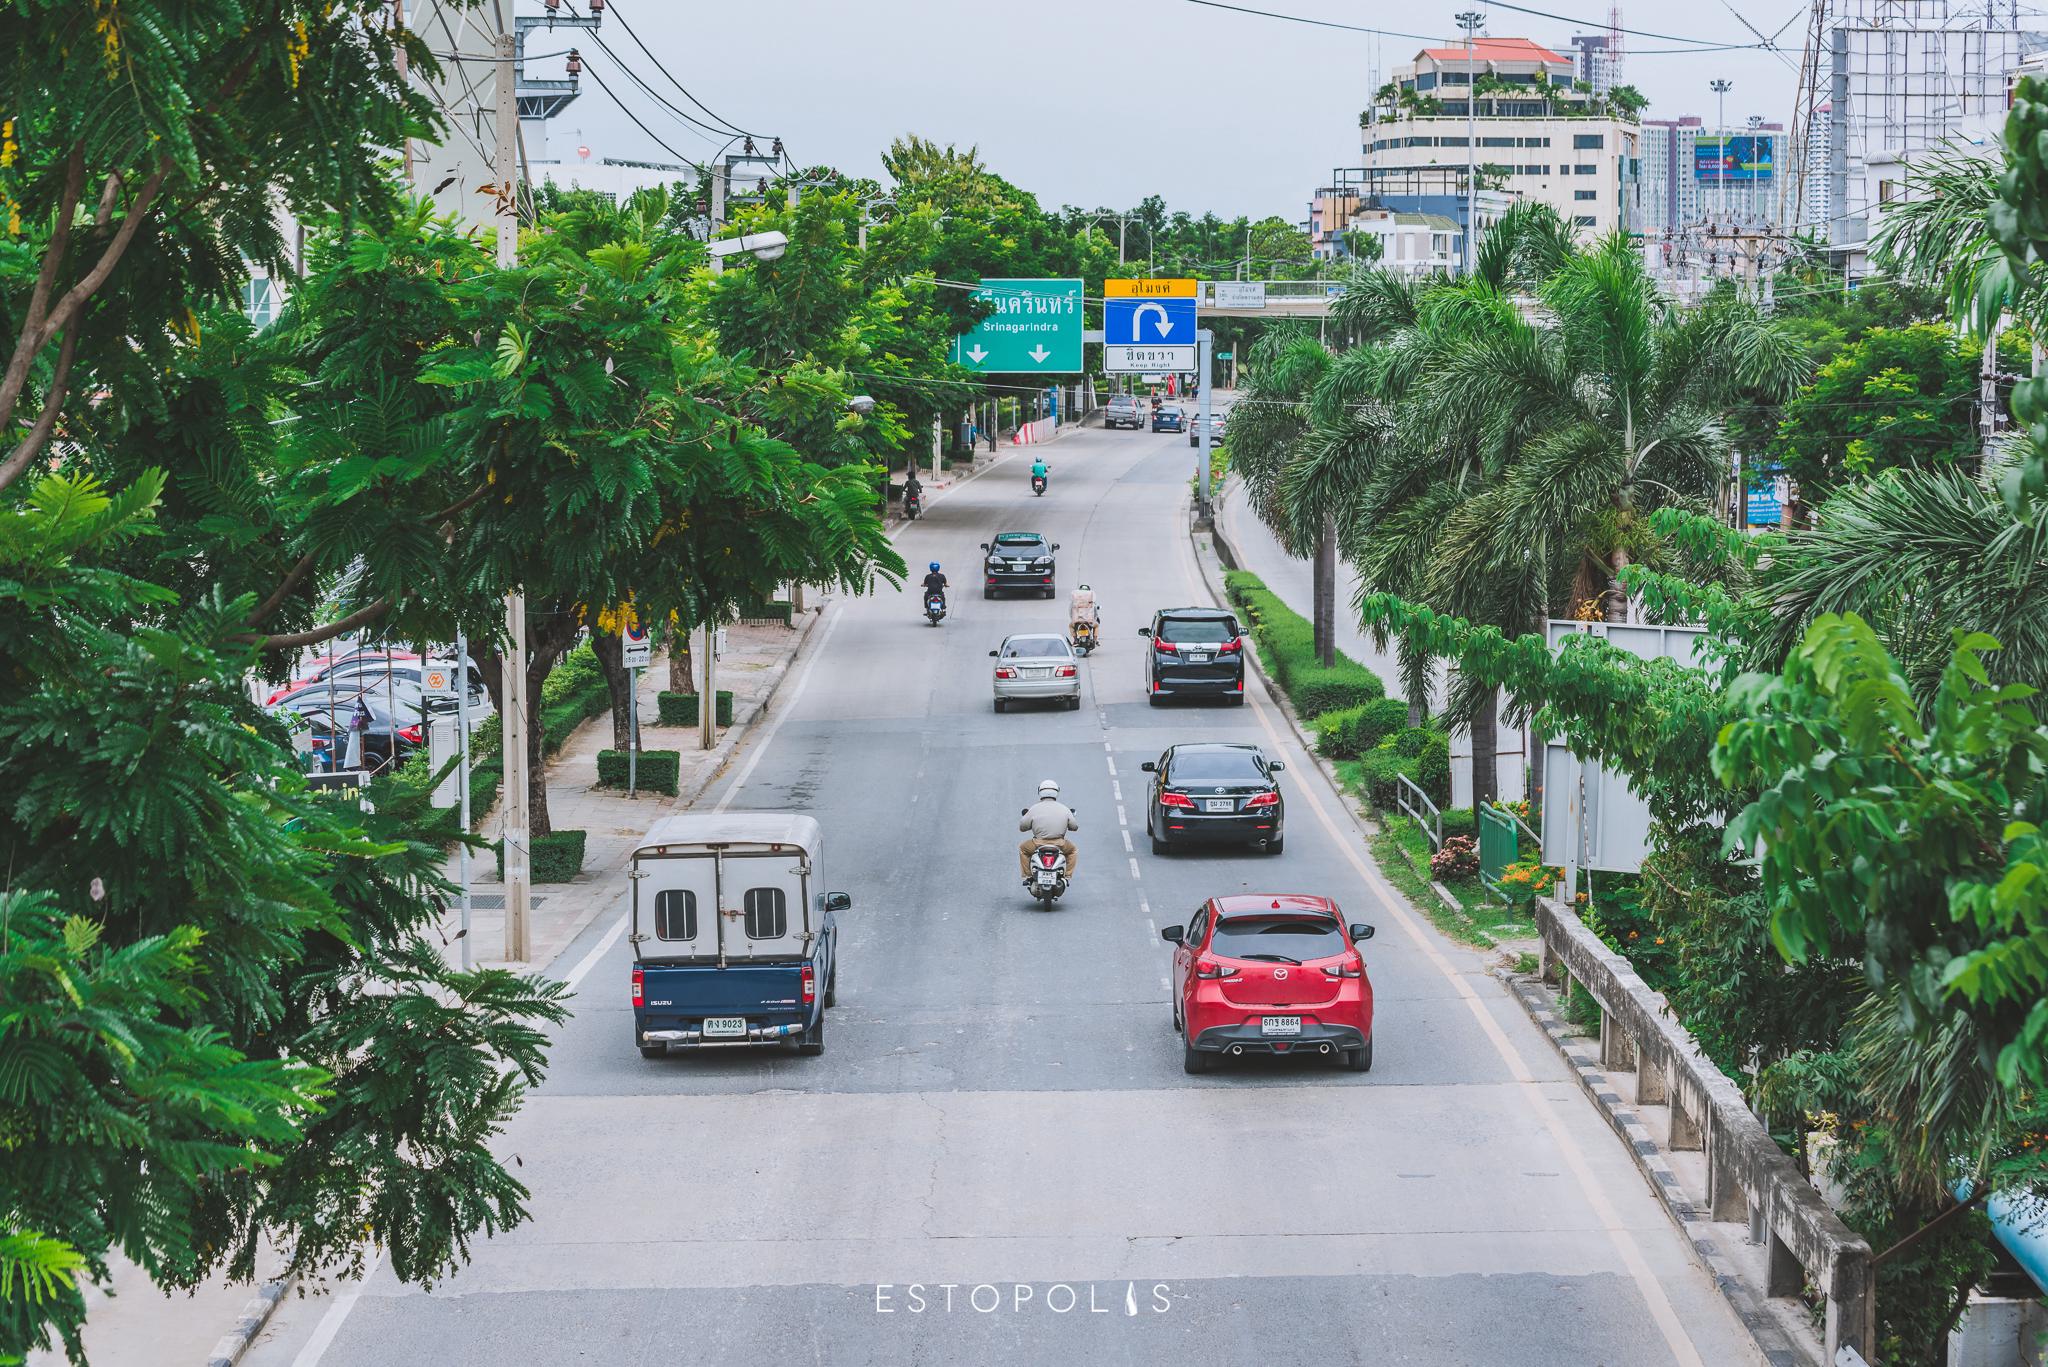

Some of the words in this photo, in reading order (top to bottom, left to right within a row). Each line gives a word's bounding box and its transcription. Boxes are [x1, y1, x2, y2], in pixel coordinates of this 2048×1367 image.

[1131, 280, 1171, 296] อุโมงค์
[983, 322, 1059, 334] Srinagarindra
[1125, 348, 1175, 361] ชิดขวา
[722, 1019, 743, 1029] 9023
[1280, 1018, 1299, 1026] 8864
